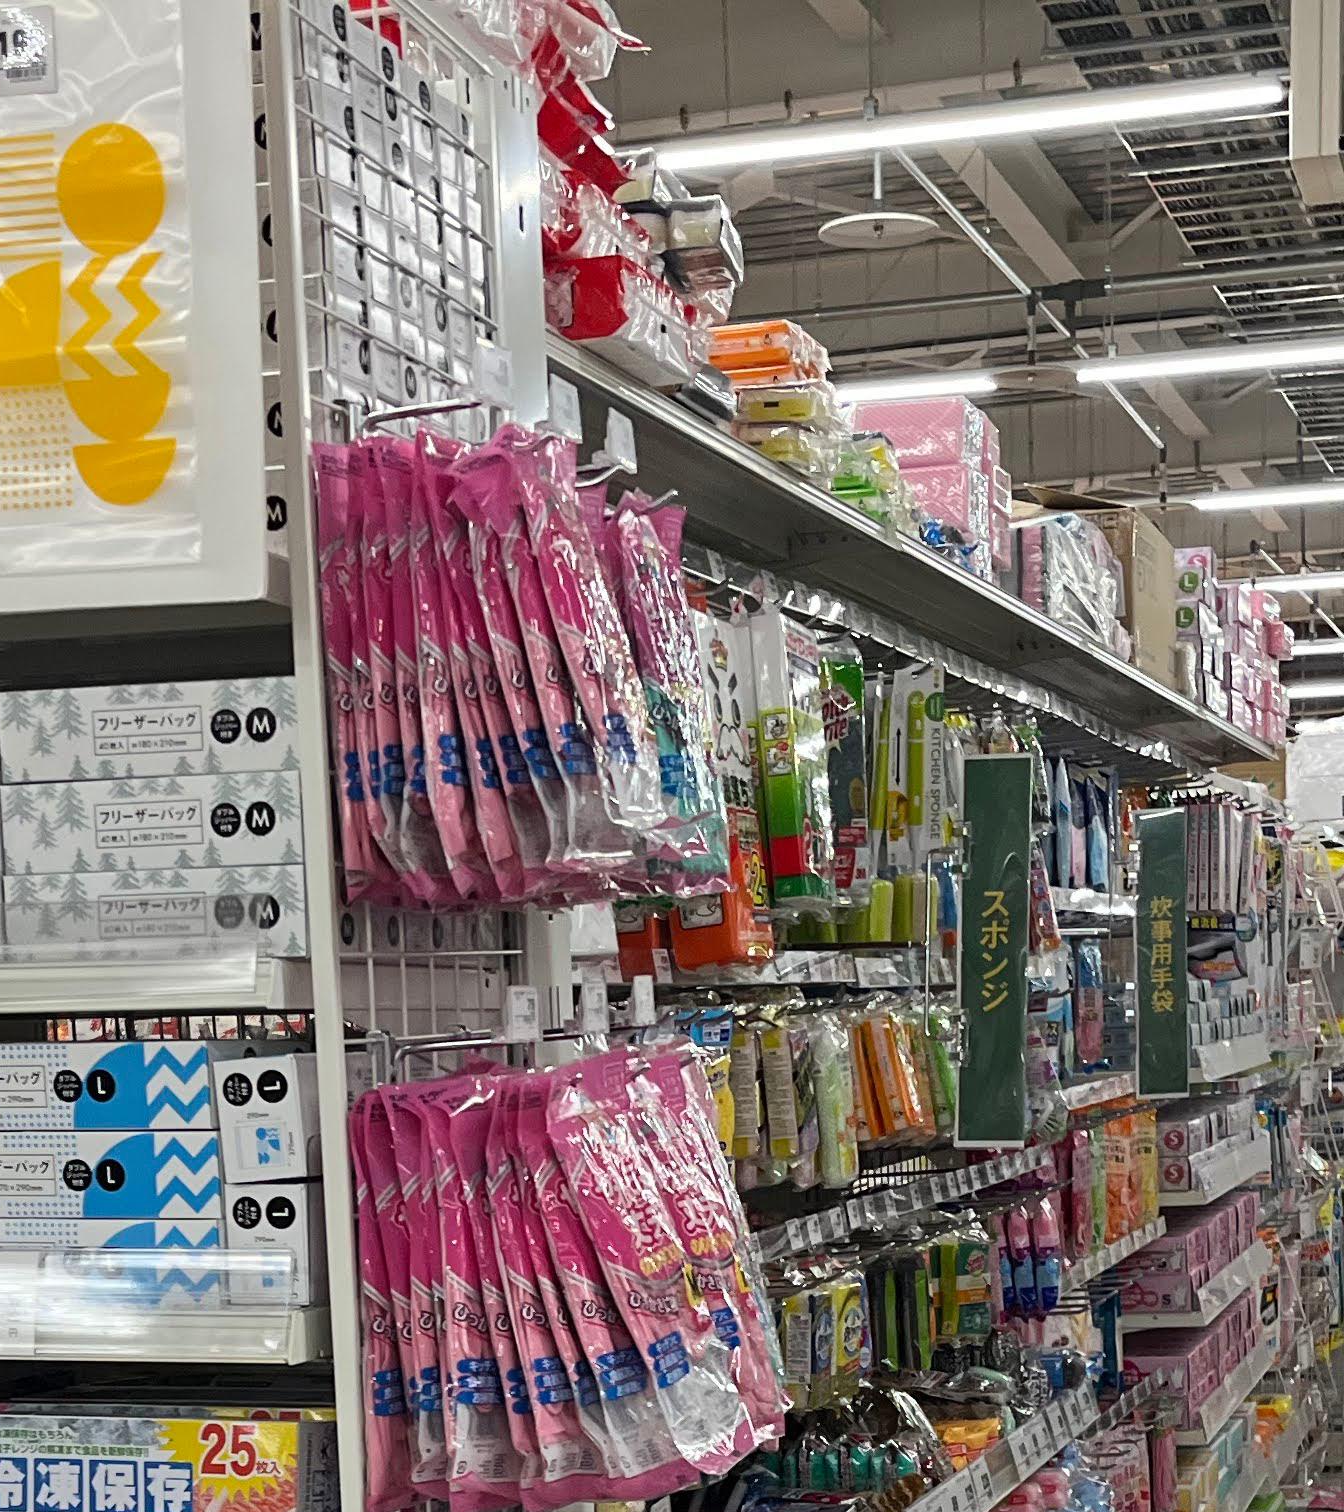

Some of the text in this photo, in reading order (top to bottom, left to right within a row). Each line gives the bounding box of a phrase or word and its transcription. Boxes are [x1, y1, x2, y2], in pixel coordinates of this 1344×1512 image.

[96, 711, 198, 733] フリーザーバッグ
[251, 715, 272, 736] M
[929, 727, 943, 841] KITCHEN SPONGE
[980, 890, 1011, 1014] スポンジ
[1149, 896, 1176, 1013] 炊事用手袋
[96, 1076, 107, 1095] L
[201, 1423, 281, 1477] 25枚入
